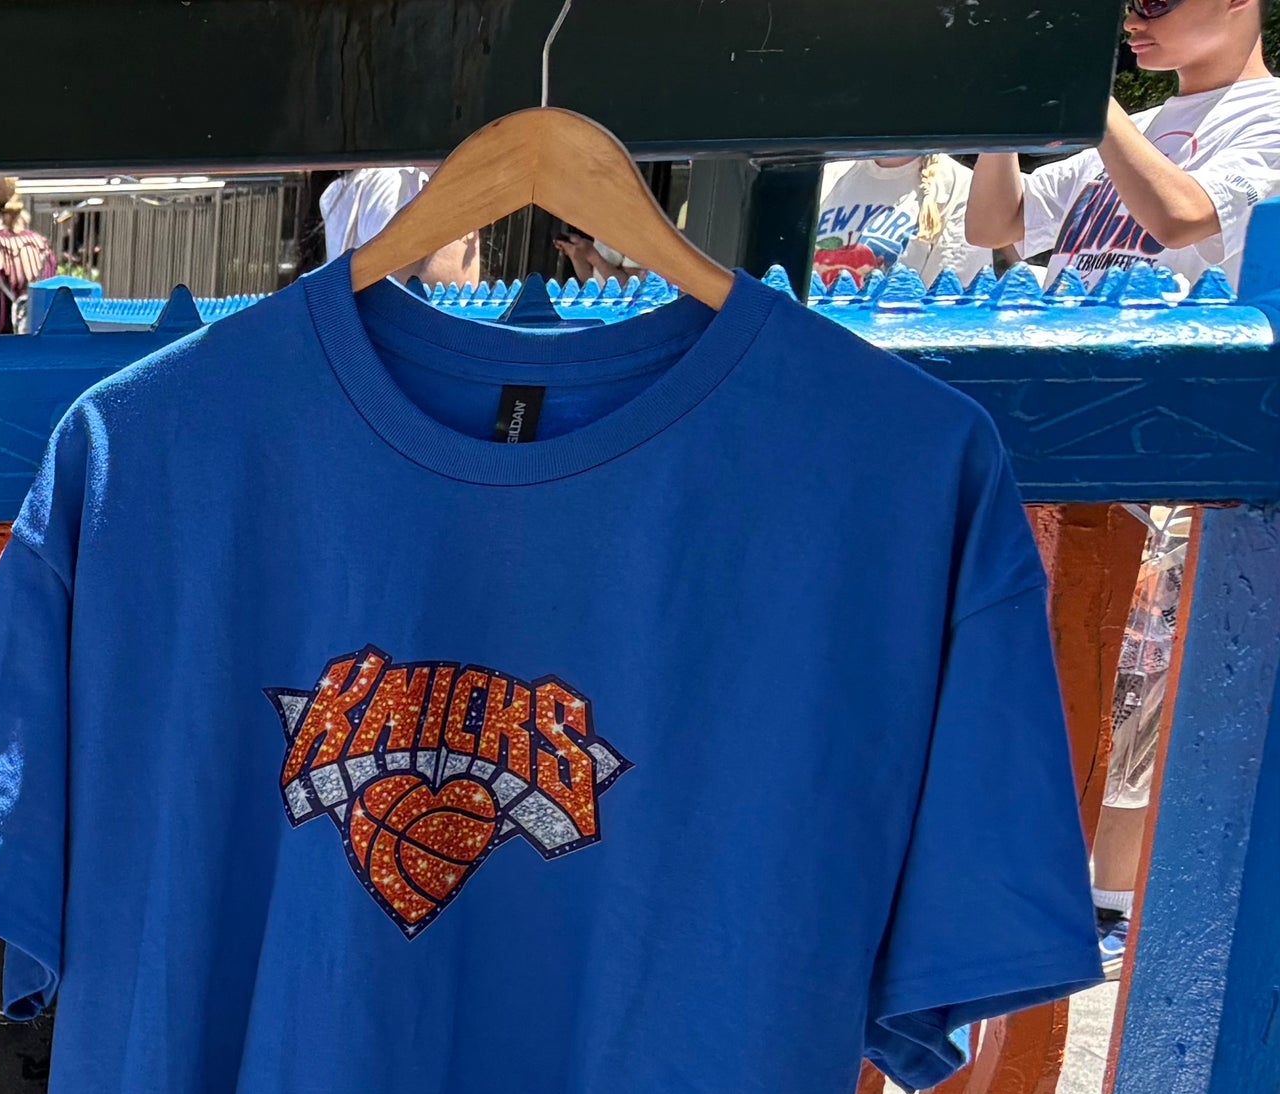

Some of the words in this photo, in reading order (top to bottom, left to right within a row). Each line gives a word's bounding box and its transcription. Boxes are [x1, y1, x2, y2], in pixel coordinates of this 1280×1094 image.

[816, 205, 860, 236] EW
[506, 400, 527, 444] GILDAN
[281, 651, 597, 838] KNICKS
